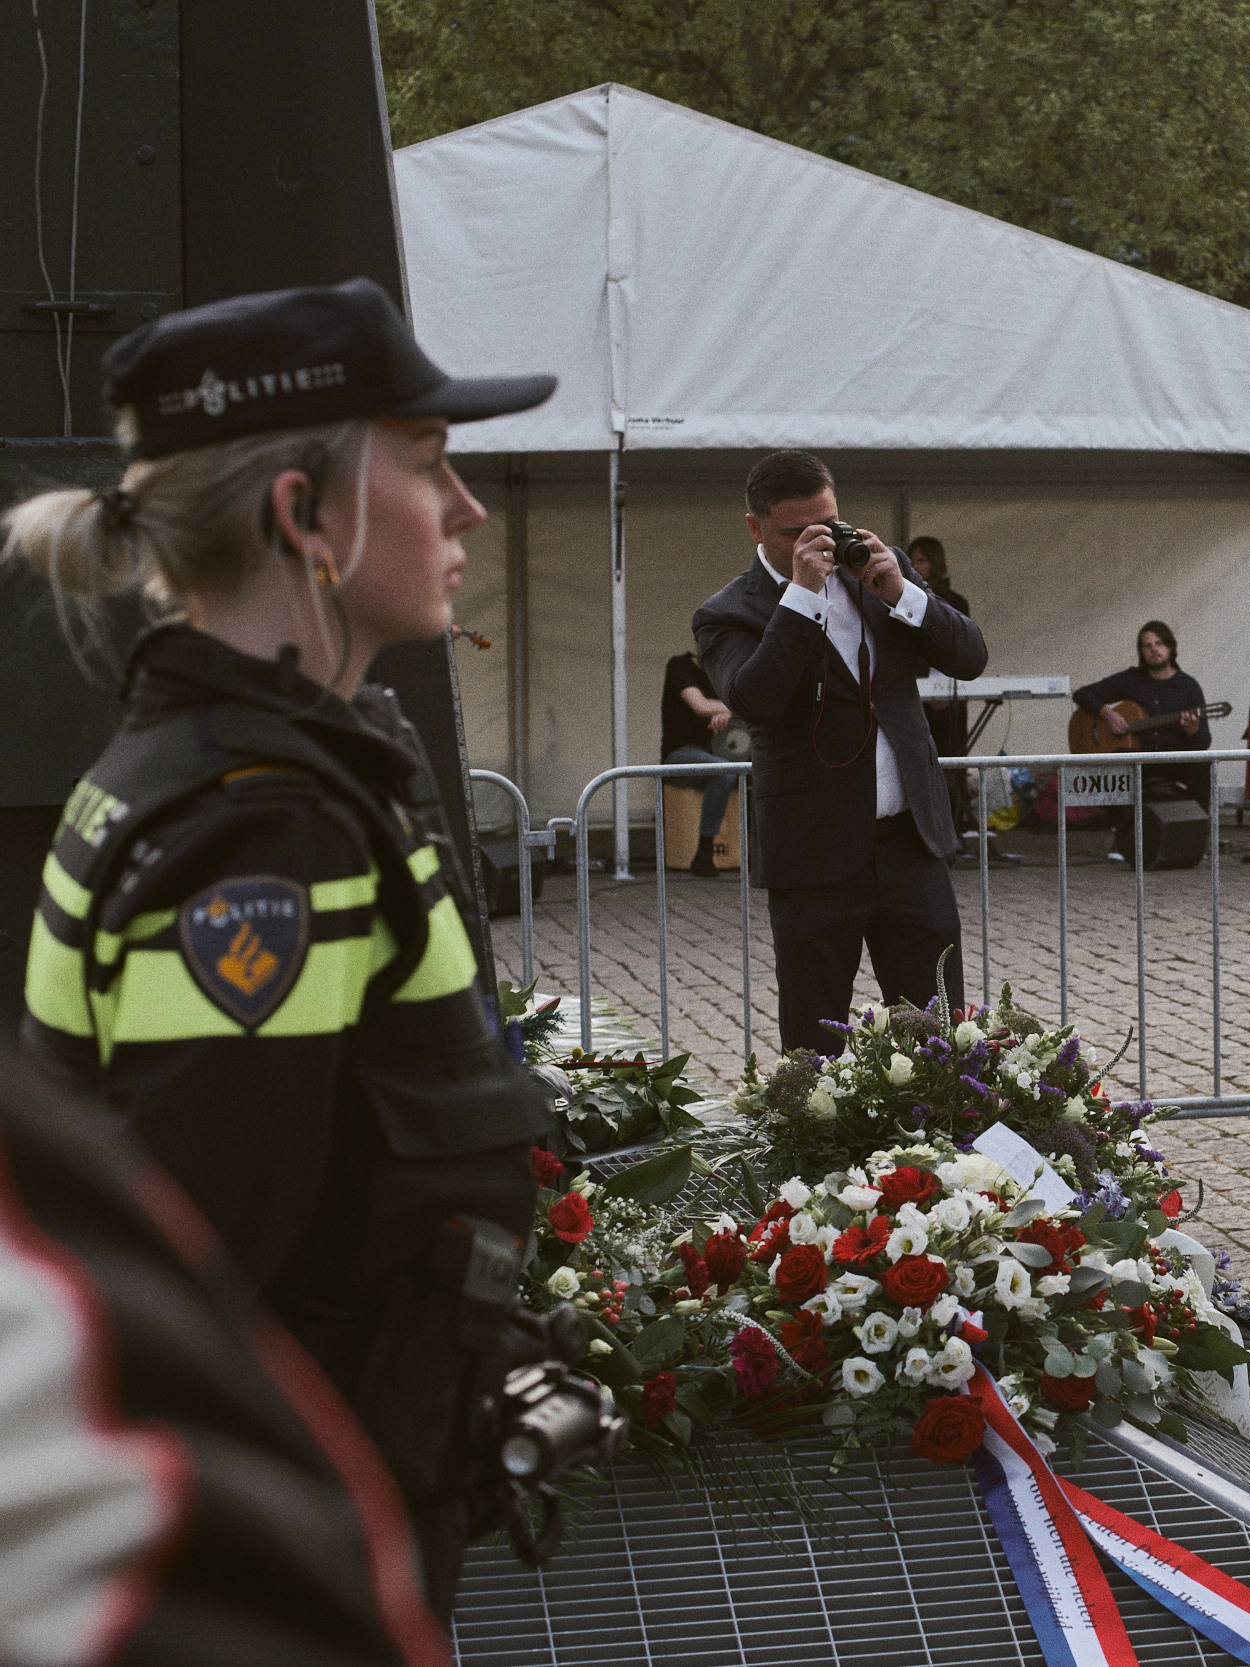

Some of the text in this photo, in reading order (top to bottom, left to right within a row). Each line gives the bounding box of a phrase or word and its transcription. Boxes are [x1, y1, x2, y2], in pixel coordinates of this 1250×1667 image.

[182, 366, 312, 417] POLITIE
[192, 898, 295, 929] POLITIE
[1003, 1489, 1074, 1630] voor onze vrijheid
[1027, 1469, 1097, 1629] Voor hen die vielen
[1078, 1509, 1183, 1575] Leden PvdA
